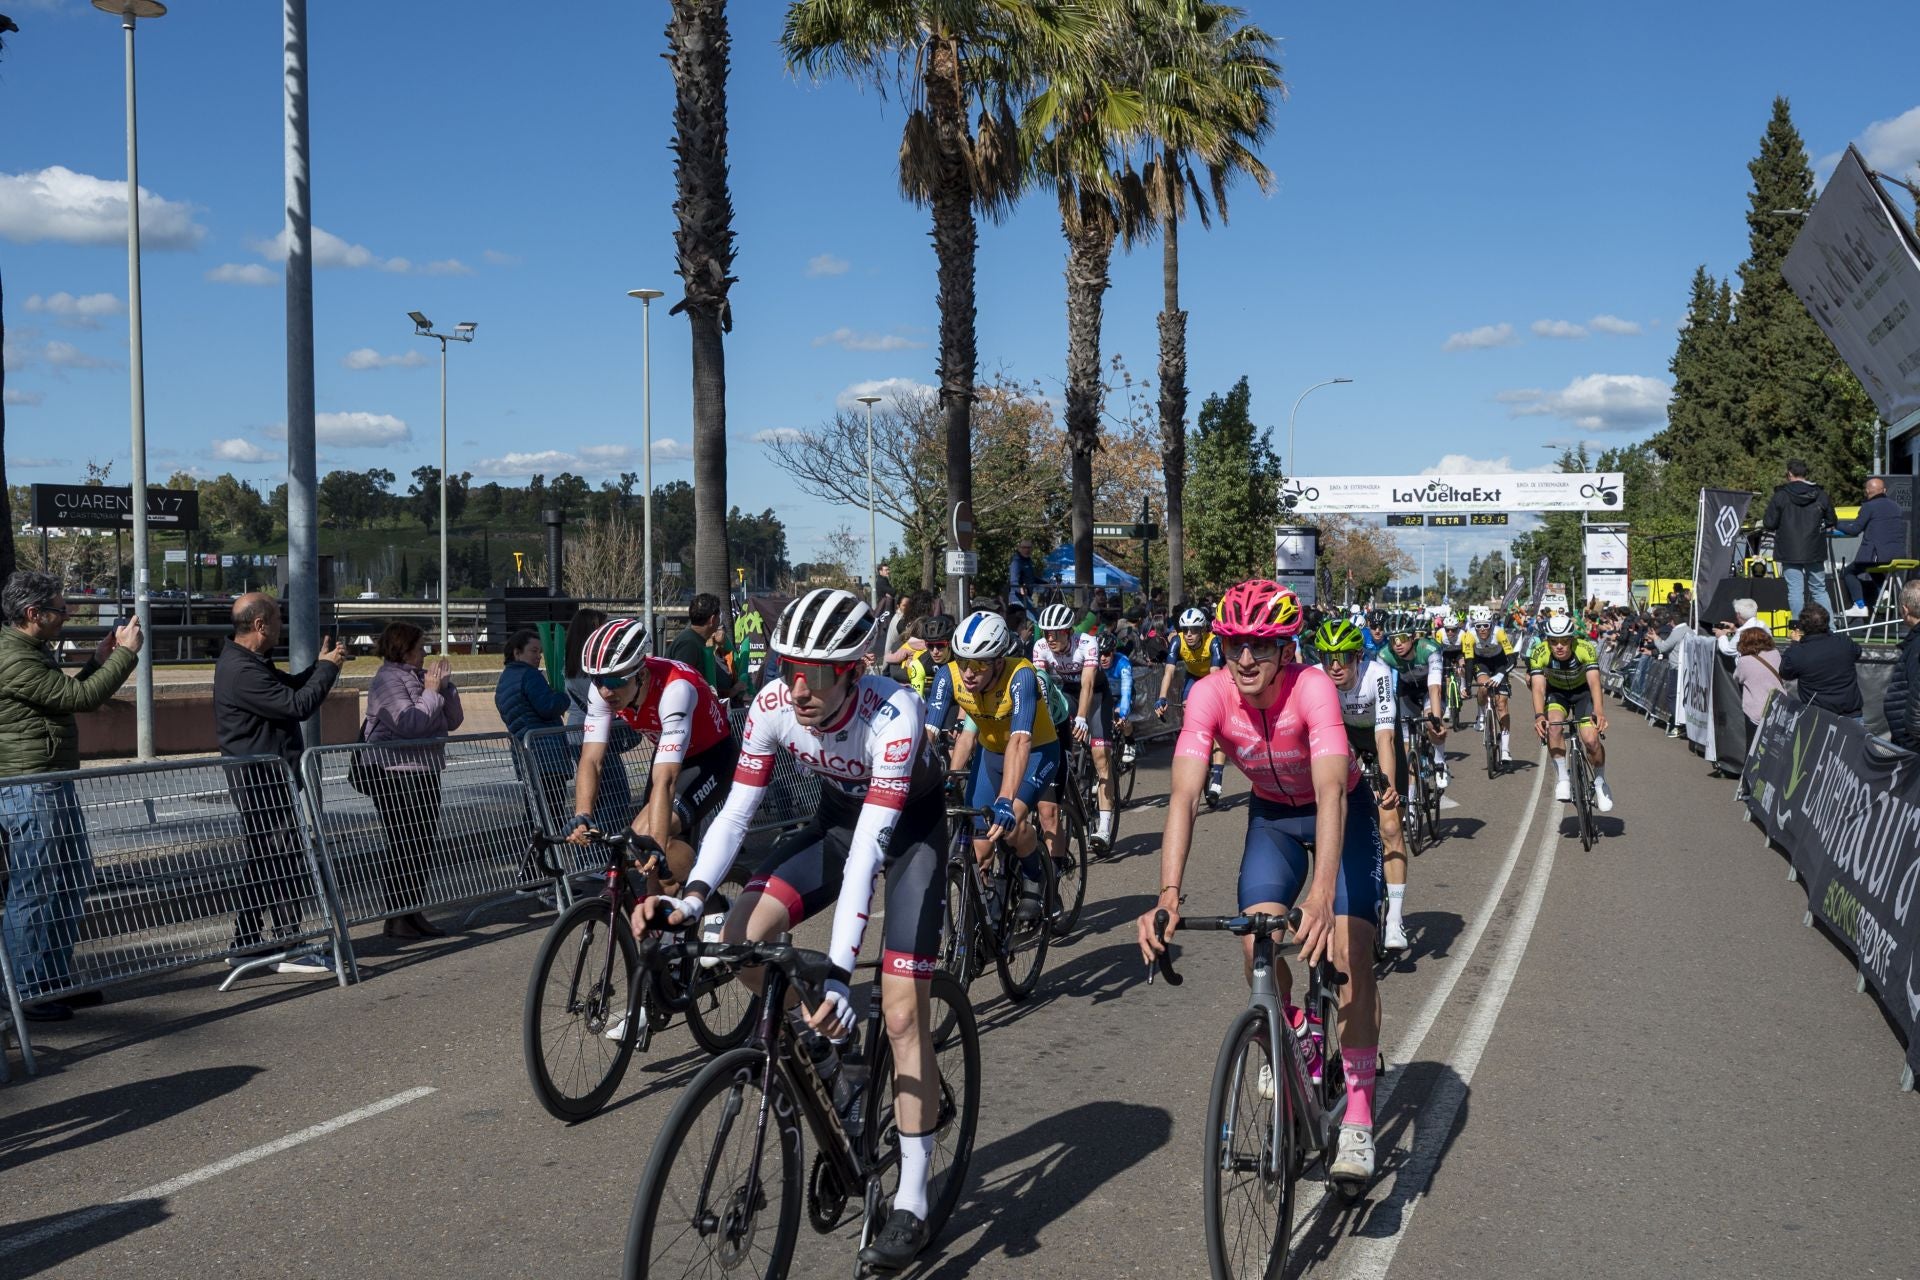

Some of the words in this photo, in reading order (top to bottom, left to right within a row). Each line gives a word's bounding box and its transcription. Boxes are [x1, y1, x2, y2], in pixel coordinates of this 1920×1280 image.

[54, 493, 151, 512] CUAREN
[157, 497, 168, 511] Y
[173, 498, 183, 512] 7
[1392, 486, 1502, 504] LaVueltaExt
[58, 511, 68, 519] 47
[692, 774, 718, 806] FROIZ
[893, 957, 935, 973] osés
